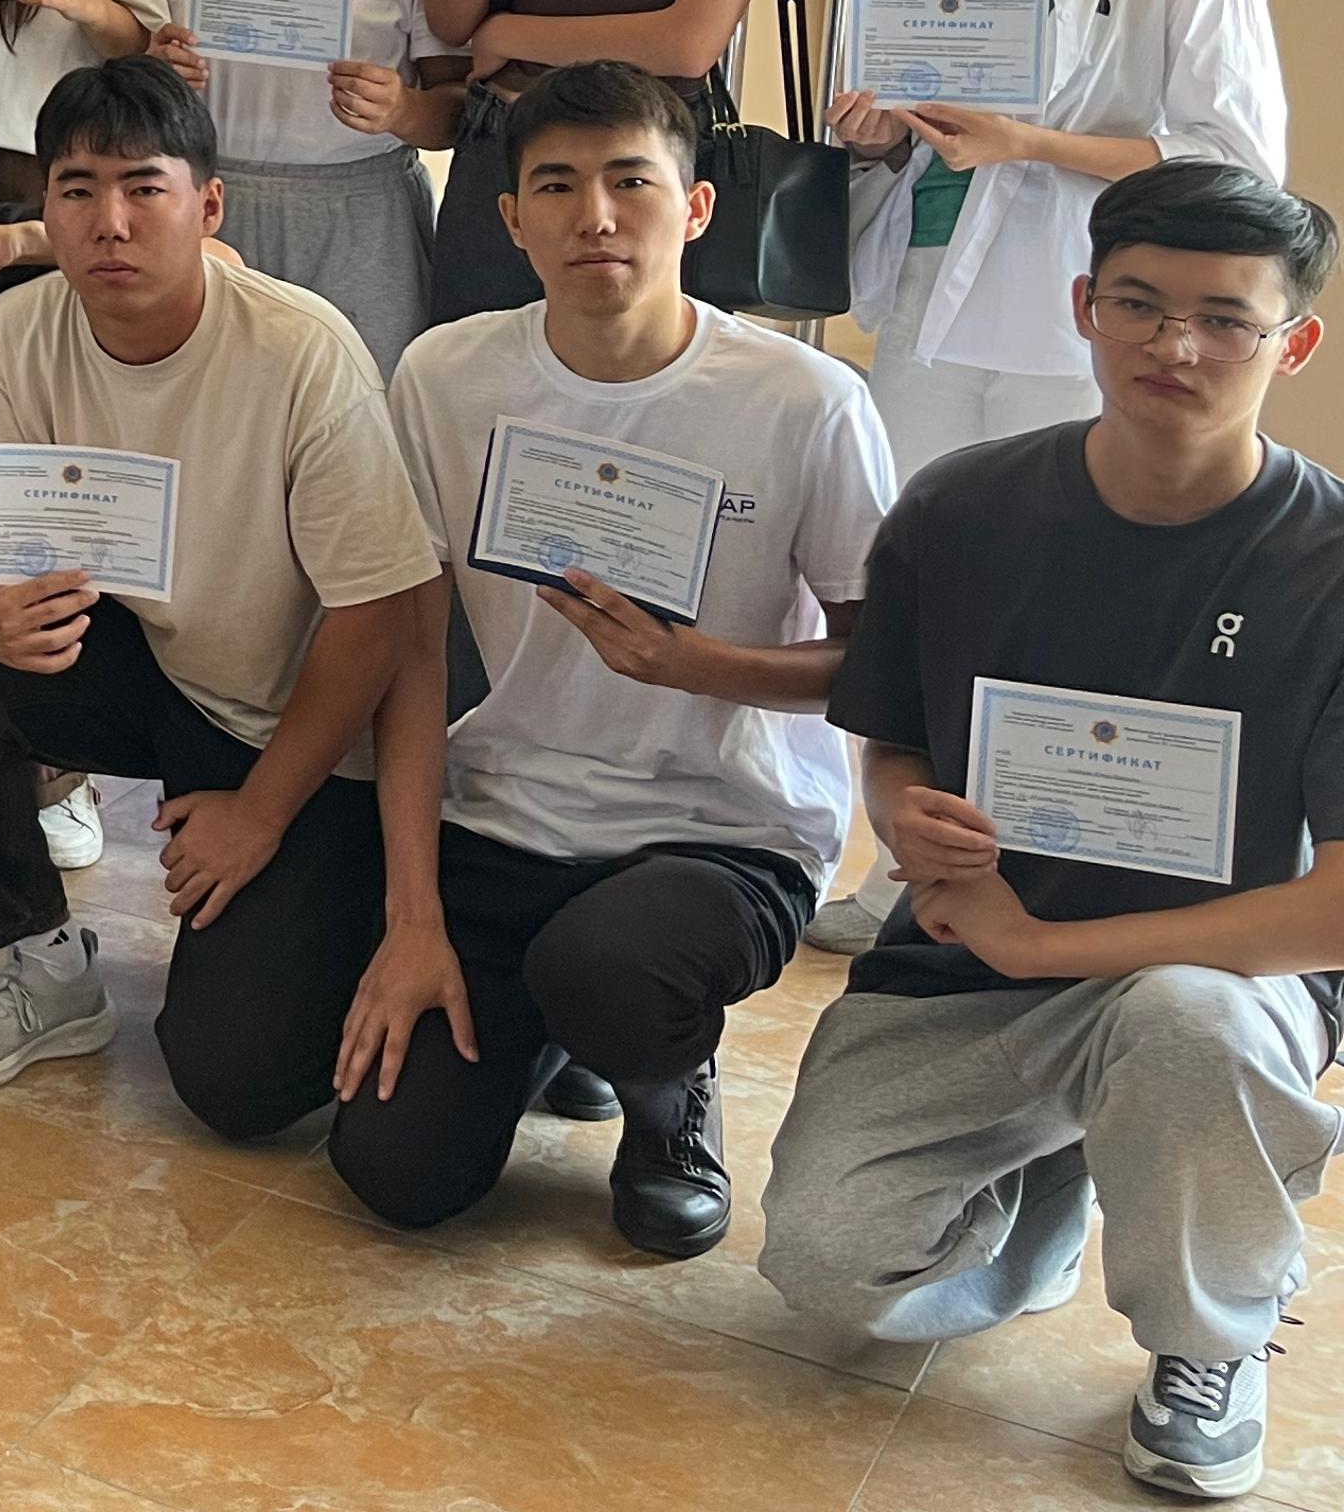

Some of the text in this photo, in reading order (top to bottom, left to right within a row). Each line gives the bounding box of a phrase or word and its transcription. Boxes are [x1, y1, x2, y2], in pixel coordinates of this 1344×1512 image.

[903, 19, 995, 30] СЕРТИФИКАТ
[24, 489, 119, 504] СЕРТИФИКАТ
[554, 479, 655, 511] СЕРТИФИКАТ
[1044, 744, 1162, 771] СЕРТИФИКАТ
